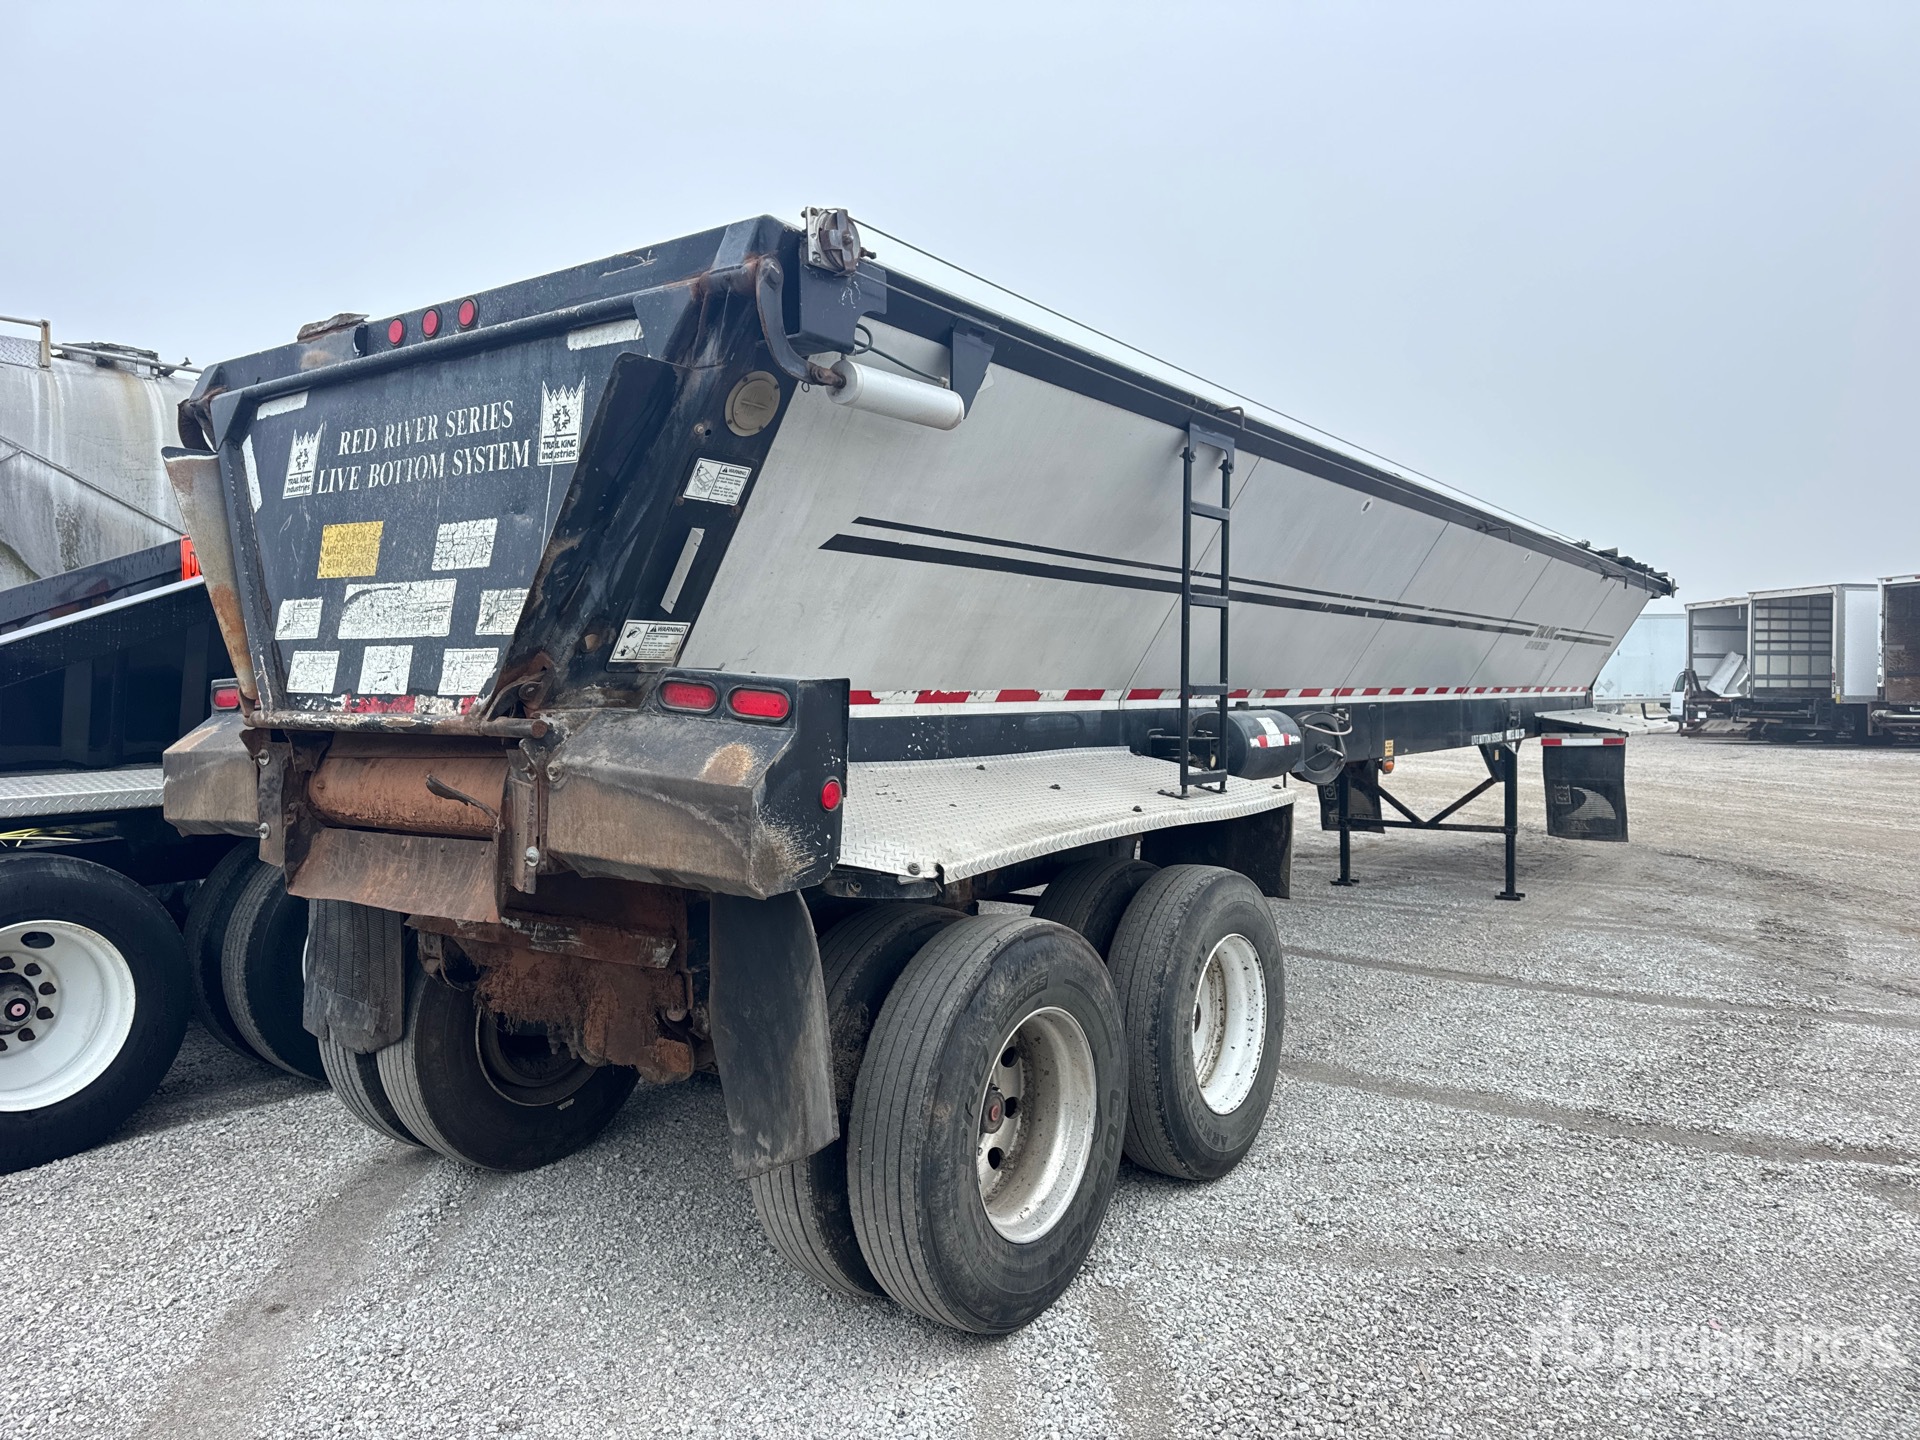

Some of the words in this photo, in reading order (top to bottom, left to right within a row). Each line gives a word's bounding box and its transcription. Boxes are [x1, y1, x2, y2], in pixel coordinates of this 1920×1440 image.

[338, 427, 377, 456] RED
[384, 414, 439, 449] RIVER
[445, 400, 514, 438] SERIES
[543, 440, 560, 450] TRAIL
[561, 439, 577, 448] KING
[541, 449, 576, 460] industries
[316, 466, 362, 495] LIVE
[368, 452, 447, 489] BOTTOM
[452, 439, 532, 477] SYSTEM
[728, 468, 748, 477] WARNING
[657, 625, 684, 633] WARNING
